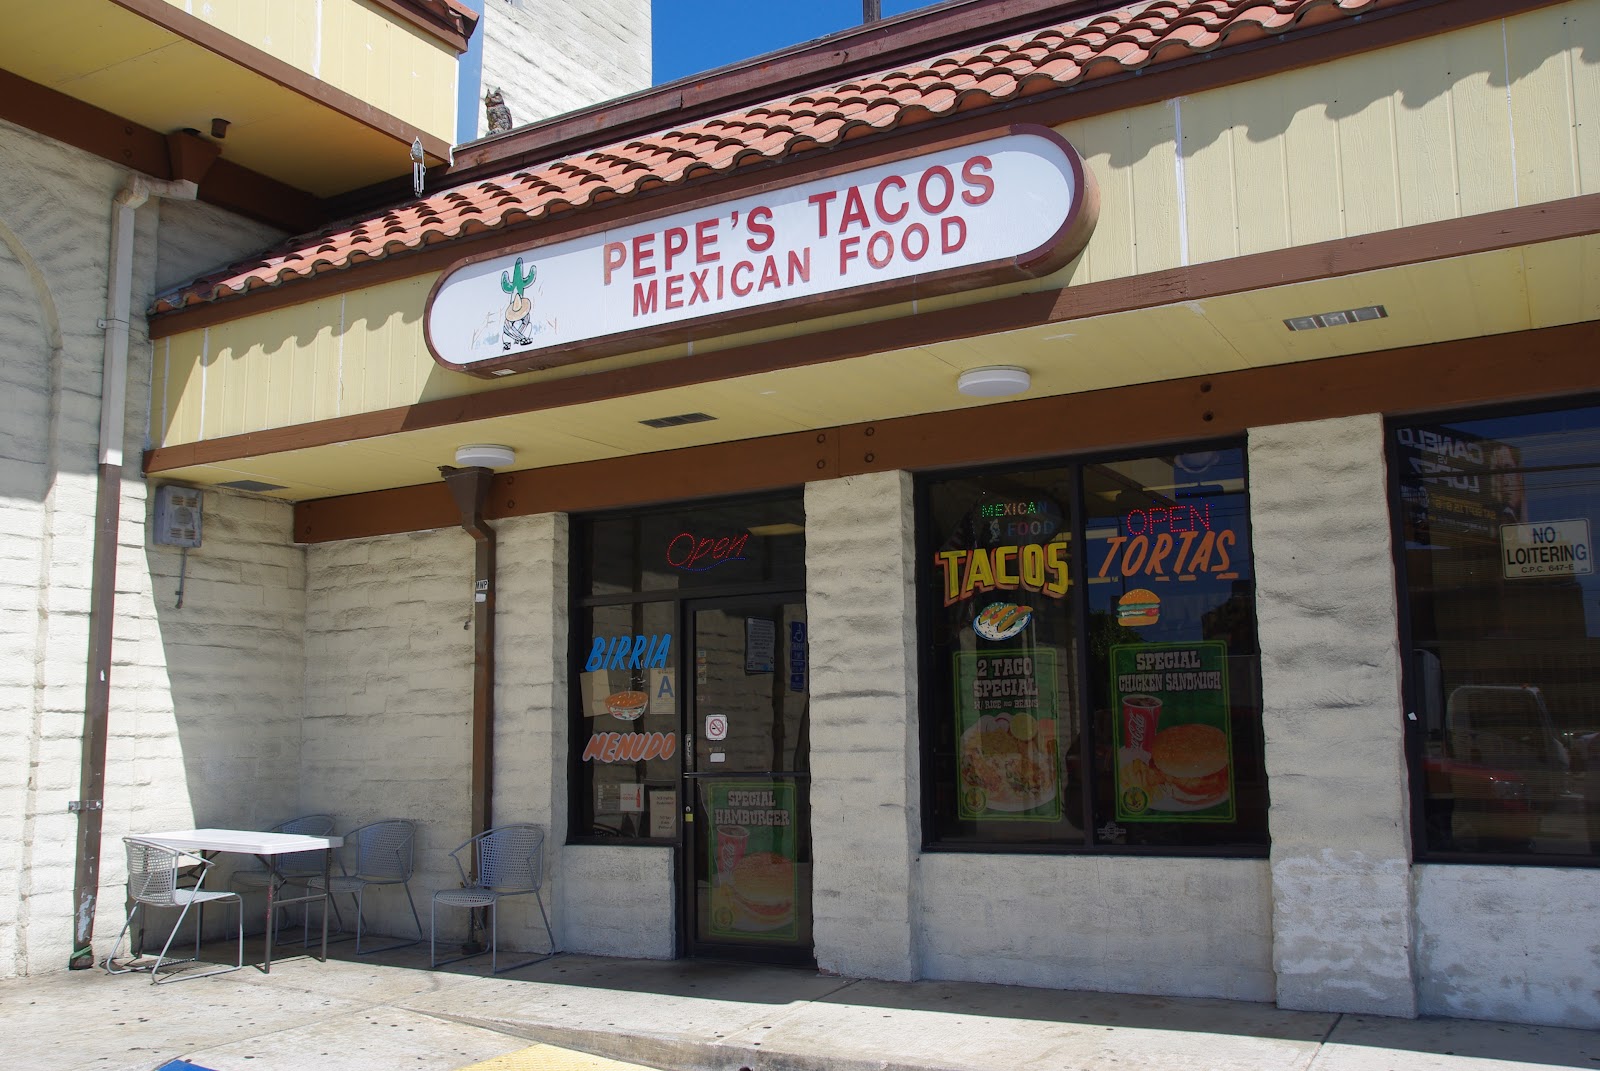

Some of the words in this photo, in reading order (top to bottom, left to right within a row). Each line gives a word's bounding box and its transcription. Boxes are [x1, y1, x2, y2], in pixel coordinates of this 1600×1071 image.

[603, 207, 775, 286] PEPE'S
[808, 154, 996, 238] TACOS
[633, 247, 811, 317] MEXICAN
[839, 215, 967, 276] FOOD
[981, 501, 1047, 518] MEXICAN
[1127, 503, 1211, 536] OPEN
[1007, 521, 1056, 537] FOOD
[1532, 526, 1556, 544] NO
[666, 533, 749, 567] Open
[1098, 529, 1236, 578] TORTAS
[1506, 543, 1587, 565] LOITERING
[934, 541, 1069, 607] TACOS
[1521, 565, 1546, 574] C.P.C.
[1548, 563, 1575, 572] 647-E
[584, 633, 673, 673] BIRRIA
[1135, 650, 1201, 671] SPECIAL
[976, 657, 988, 677] 2
[991, 656, 1033, 677] TACO
[657, 675, 675, 699] A
[973, 677, 1039, 698] SPECIAL
[1118, 671, 1163, 693] CHICKEN
[1165, 670, 1222, 692] SANDWICH
[984, 700, 1002, 710] RICE
[1014, 698, 1039, 709] BEANS
[582, 731, 677, 763] MENUDO
[727, 790, 777, 808] SPECIAL
[714, 808, 791, 827] HAMBURGER
